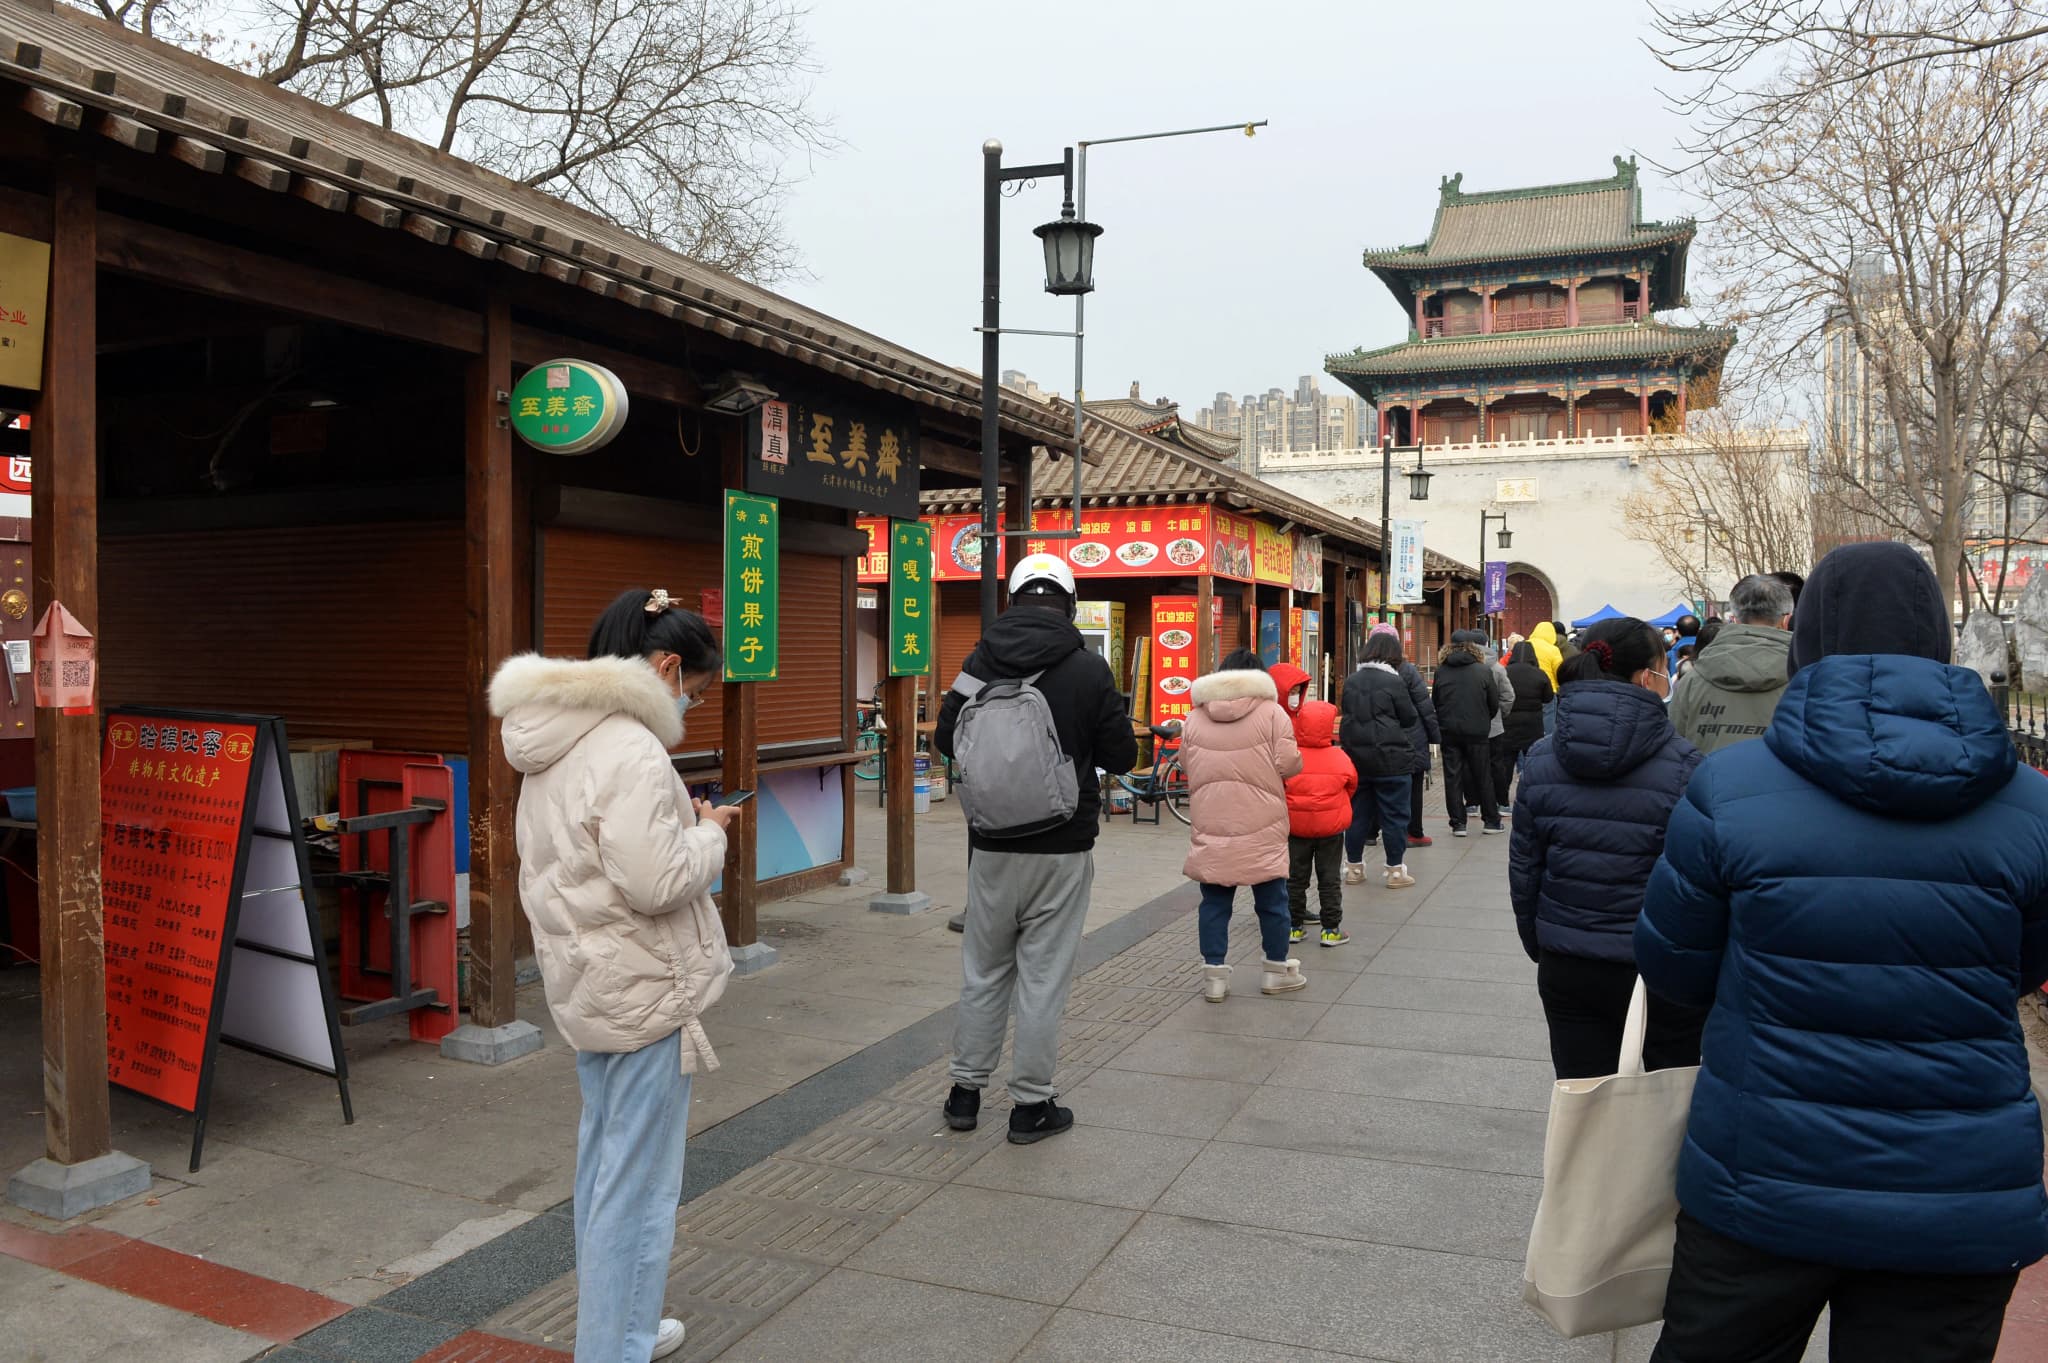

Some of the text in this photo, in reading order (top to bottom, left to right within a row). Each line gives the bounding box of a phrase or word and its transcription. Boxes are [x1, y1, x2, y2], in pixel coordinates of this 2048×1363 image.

[767, 405, 784, 460] 清真
[736, 510, 770, 525] 清真
[1071, 521, 1111, 535] 油凉皮
[900, 534, 925, 547] 清真
[739, 532, 765, 663] 煎饼果子
[901, 559, 921, 656] 嘎巴菜
[112, 729, 133, 743] 清真
[139, 723, 223, 758] 蛤蟆吐蜜
[228, 740, 250, 755] 清真
[129, 757, 221, 788] 非物质文化遗产
